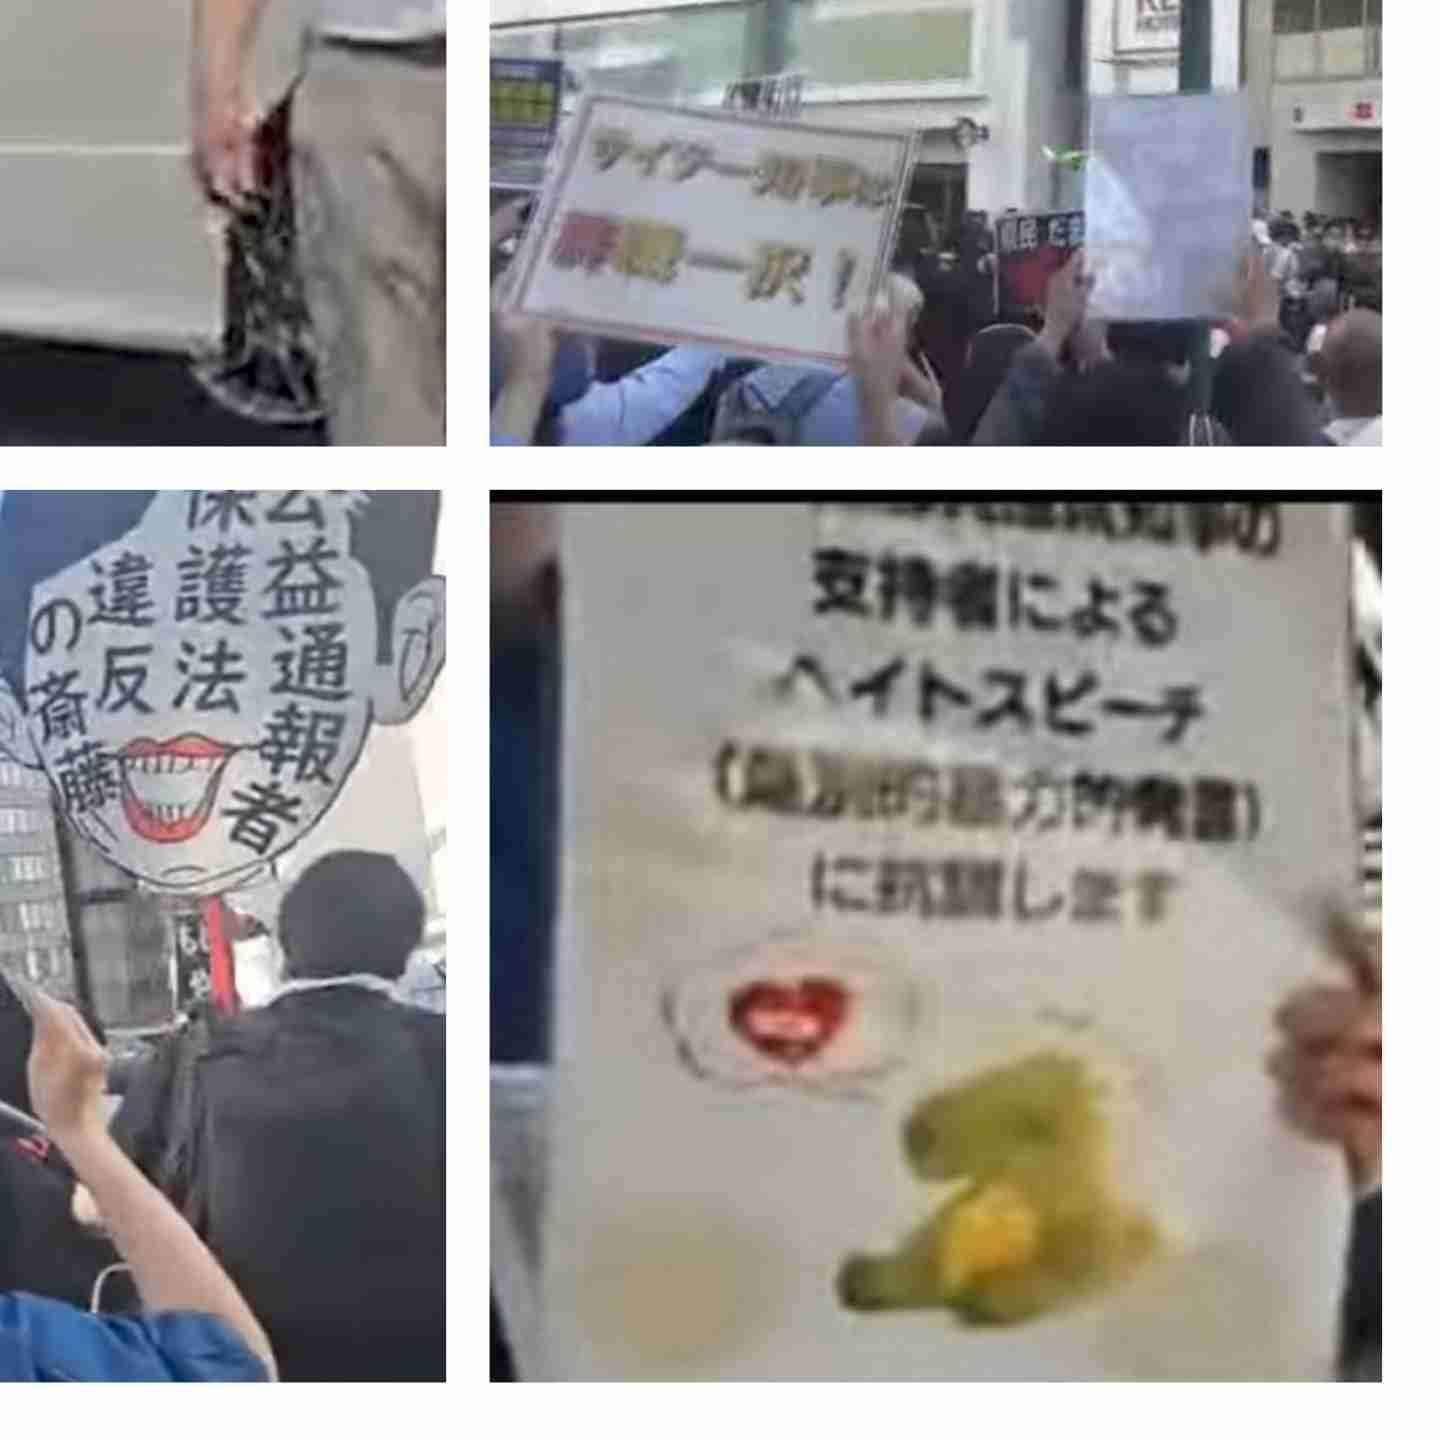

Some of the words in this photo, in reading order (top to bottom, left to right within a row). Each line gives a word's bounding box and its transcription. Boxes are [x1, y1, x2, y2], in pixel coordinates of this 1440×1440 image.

[86, 550, 158, 714] 違反
[770, 653, 1206, 744] ヘイトスピーチ
